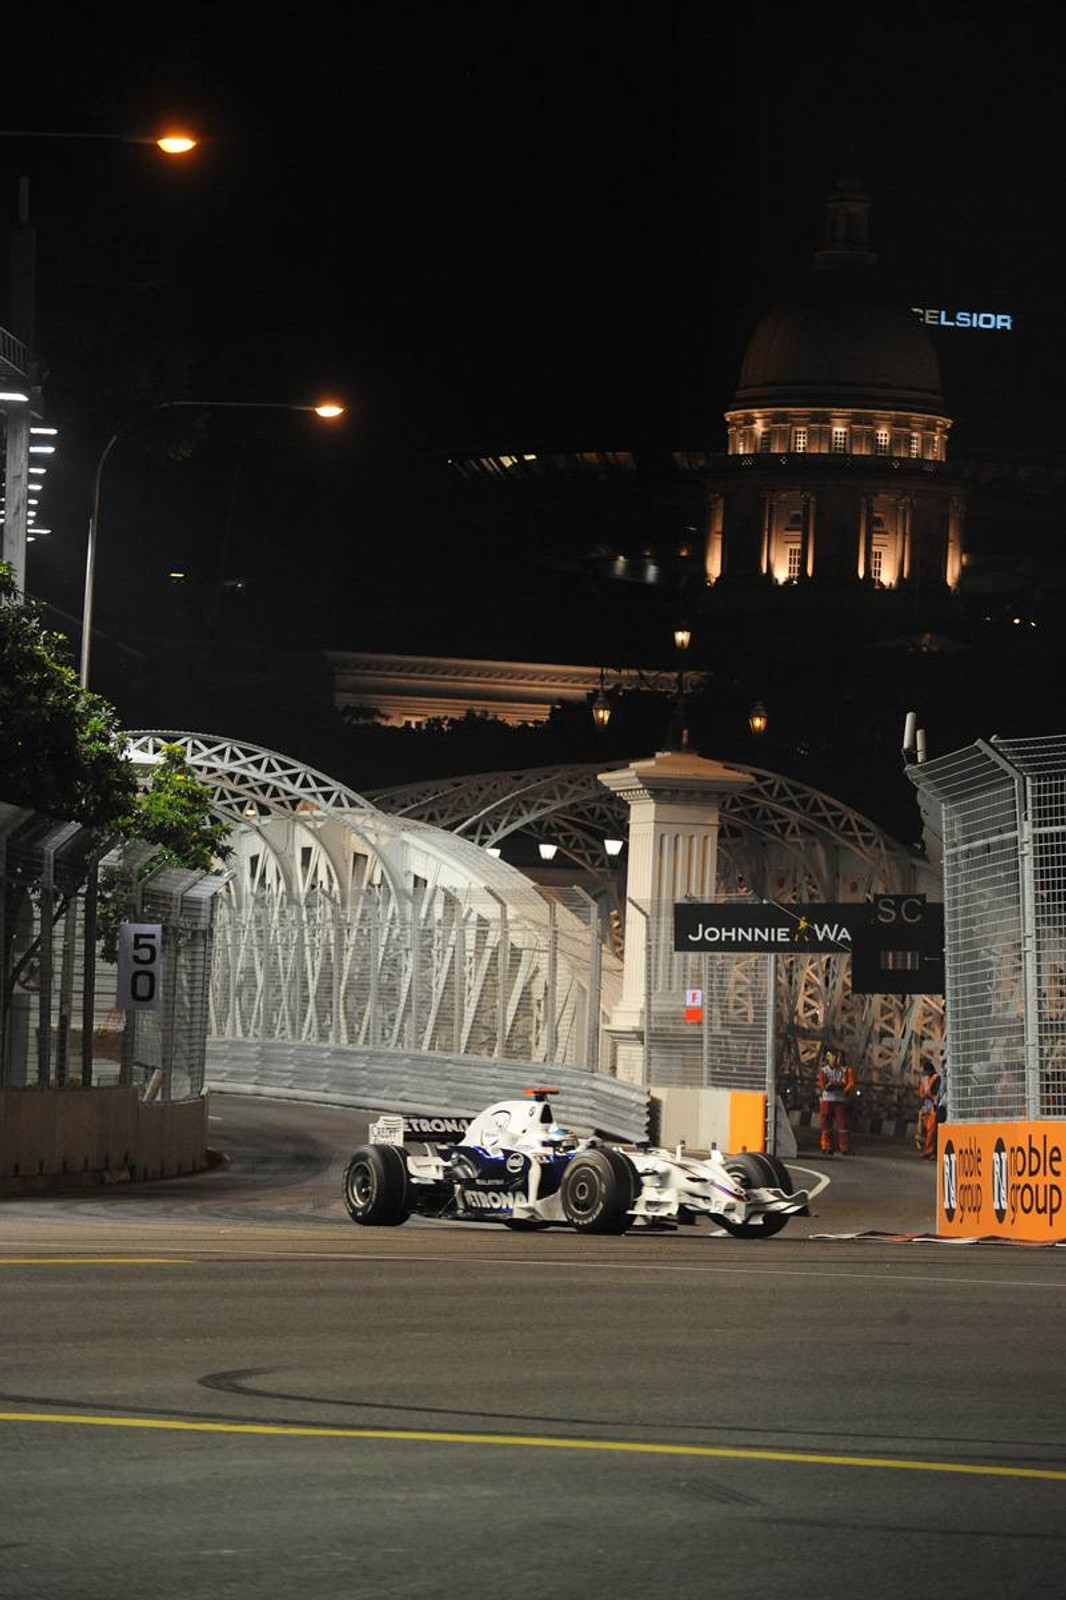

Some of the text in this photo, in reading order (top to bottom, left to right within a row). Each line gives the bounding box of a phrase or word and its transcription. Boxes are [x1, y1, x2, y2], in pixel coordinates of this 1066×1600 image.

[877, 898, 922, 923] SC
[687, 923, 790, 942] JOHNNIE
[958, 1136, 982, 1177] noble
[1010, 1134, 1062, 1177] noble
[958, 1183, 982, 1224] group
[1010, 1183, 1063, 1227] group
